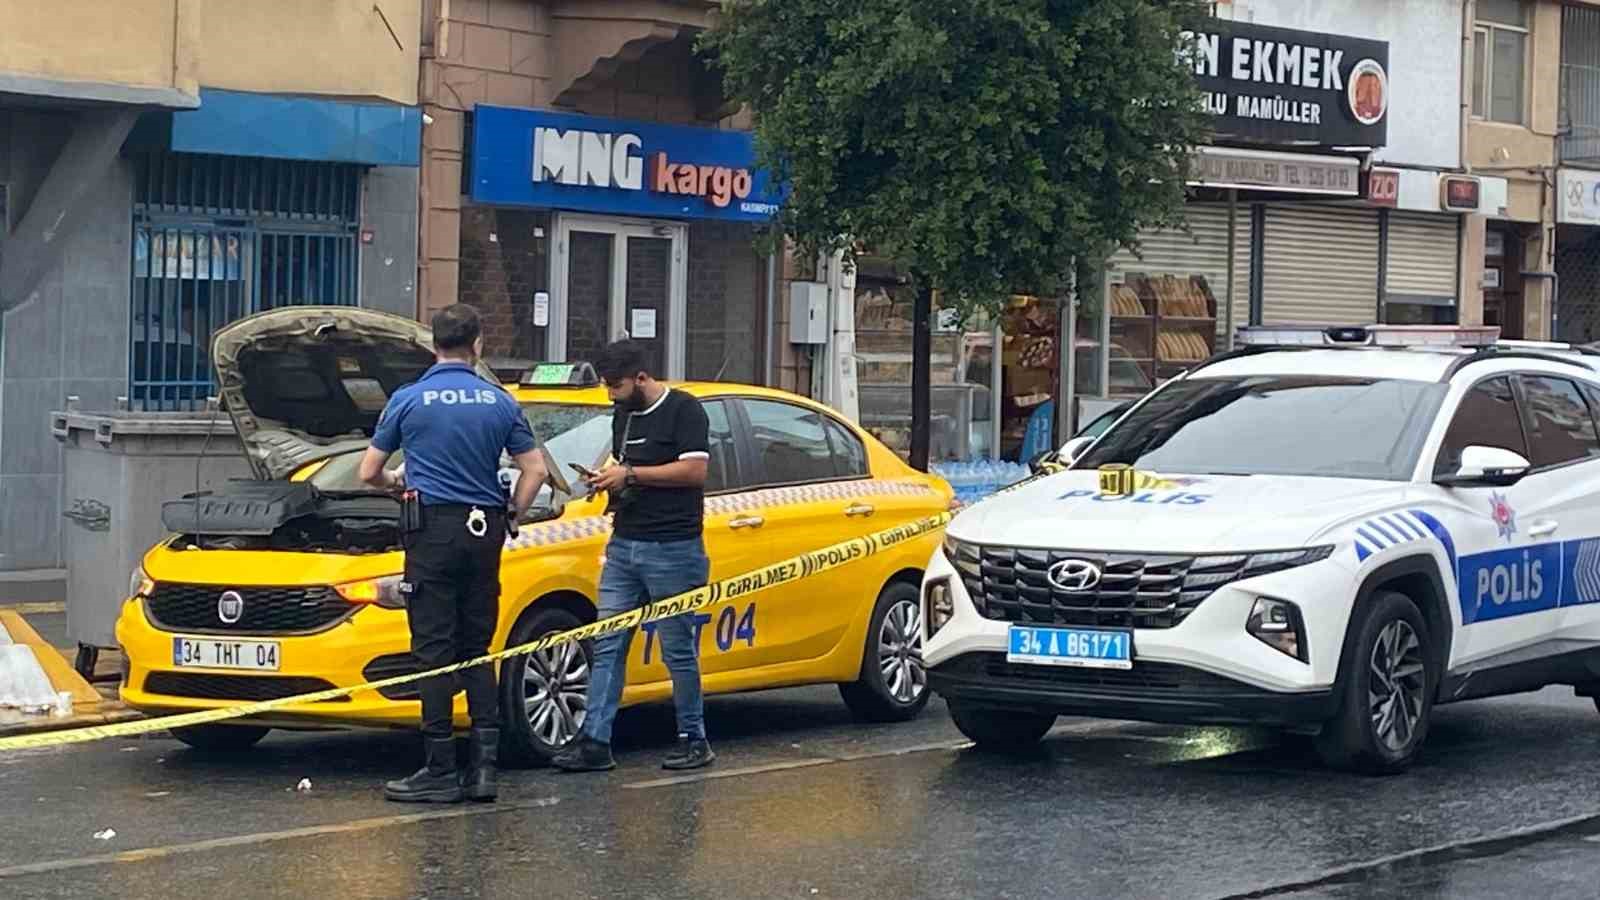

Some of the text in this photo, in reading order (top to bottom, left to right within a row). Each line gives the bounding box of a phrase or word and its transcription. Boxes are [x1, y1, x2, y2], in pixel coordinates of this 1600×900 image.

[1232, 37, 1343, 90] EKMEK
[1237, 95, 1321, 124] MAMÜLLER
[532, 126, 752, 207] MNG kargo
[183, 641, 276, 667] 34 THT 04
[640, 602, 756, 665] TT 04
[1019, 631, 1042, 654] 34
[1048, 632, 1060, 656] A
